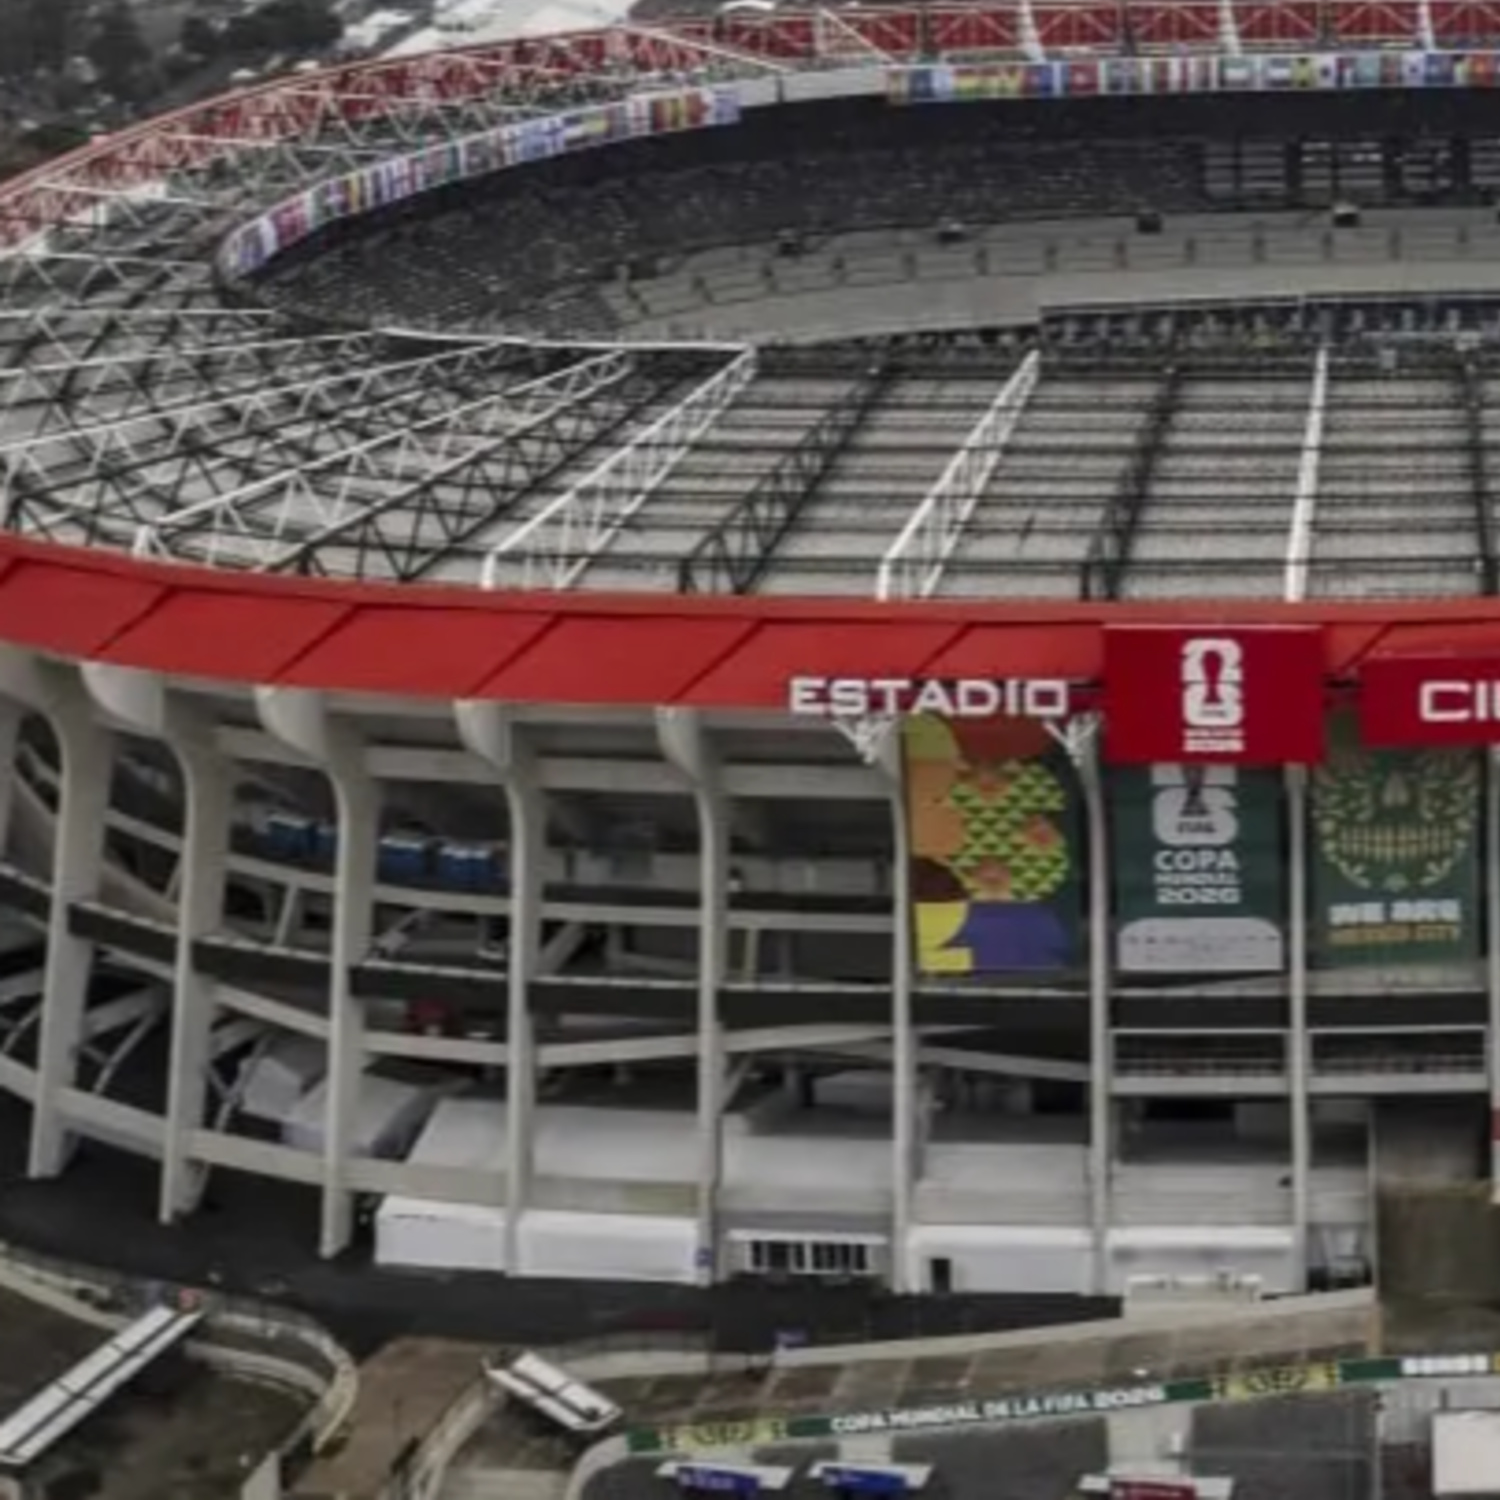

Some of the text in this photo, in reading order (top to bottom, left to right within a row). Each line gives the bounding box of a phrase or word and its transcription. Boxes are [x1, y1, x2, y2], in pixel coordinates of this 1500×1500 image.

[790, 678, 1069, 716] ESTADIO
[1154, 850, 1240, 871] COPA
[1156, 887, 1241, 904] 2026
